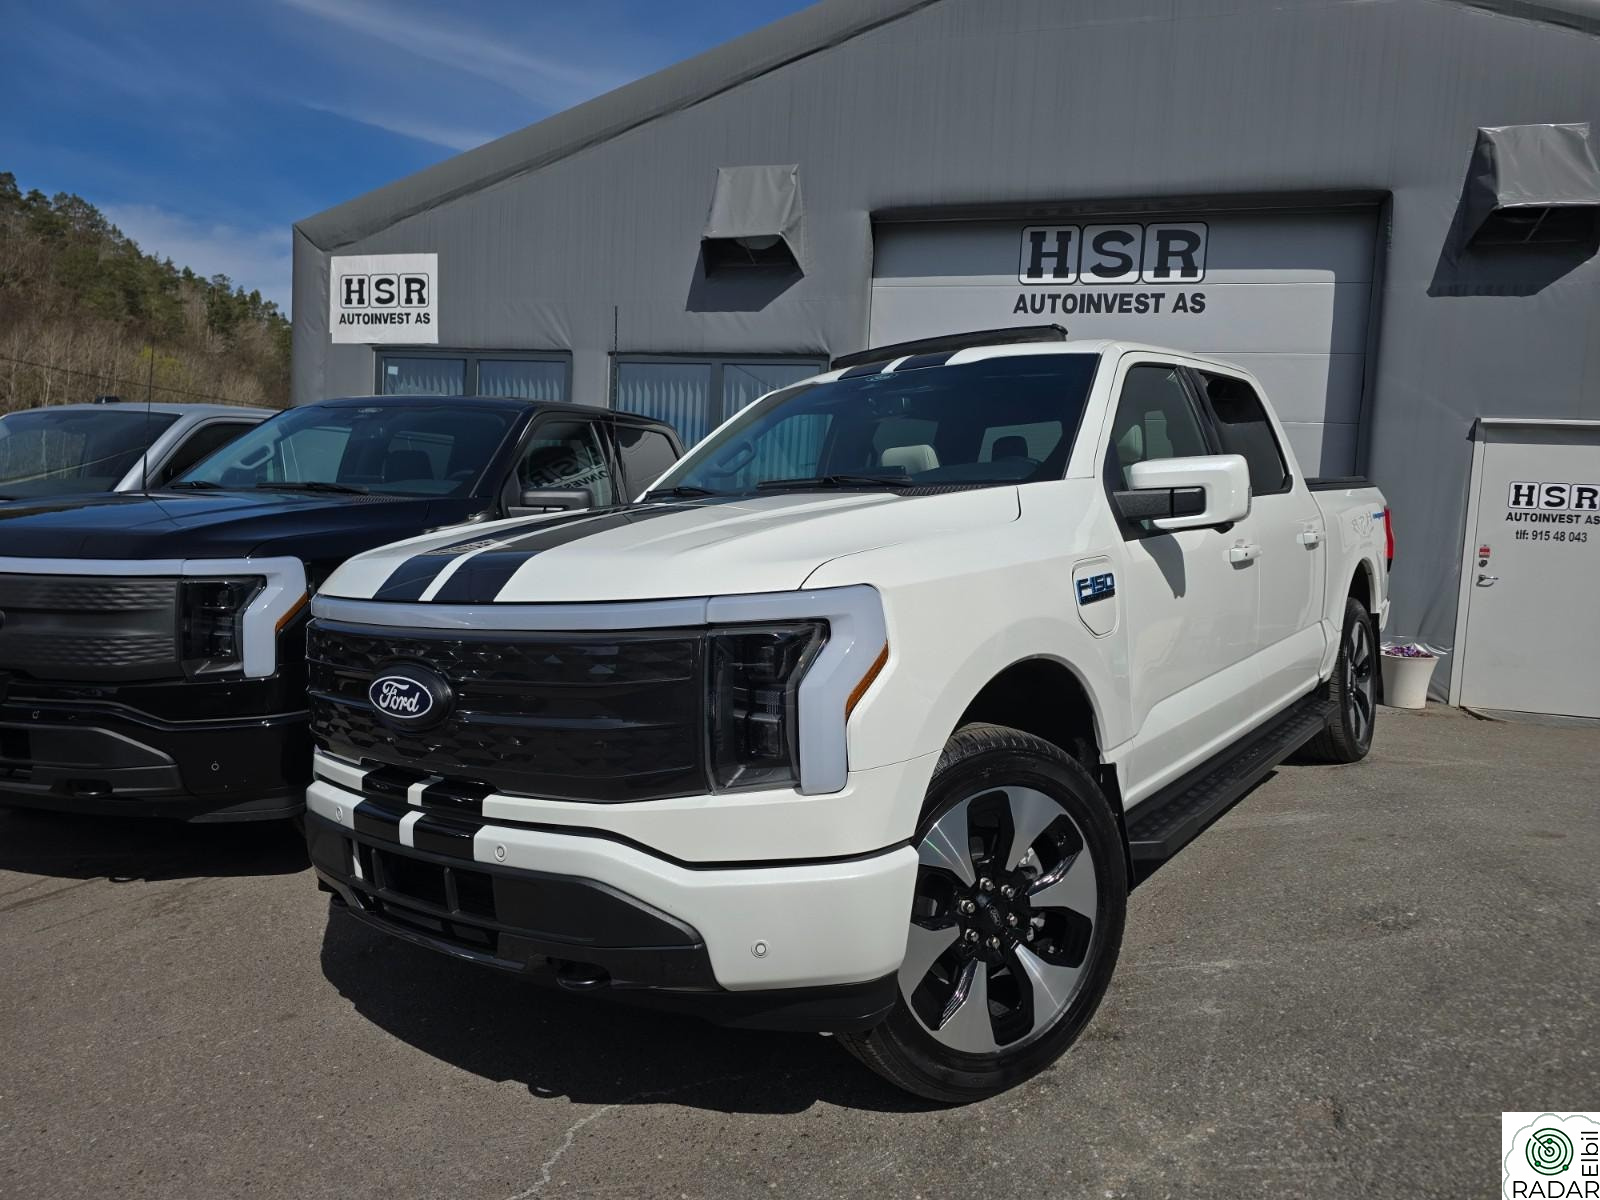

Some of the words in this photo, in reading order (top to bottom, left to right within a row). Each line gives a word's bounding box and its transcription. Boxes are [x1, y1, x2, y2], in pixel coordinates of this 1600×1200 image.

[1027, 229, 1201, 279] HSR
[344, 277, 426, 305] HSR
[1013, 293, 1165, 314] AUTOINVEST
[1172, 292, 1206, 314] AS
[339, 313, 411, 325] AUTOINVEST
[415, 312, 431, 324] AS
[1512, 484, 1599, 509] HSR
[1505, 512, 1582, 524] AUTOINVEST
[1585, 515, 1600, 525] AS
[1531, 530, 1551, 541] 915
[1553, 531, 1566, 542] 48
[1568, 532, 1588, 543] 043
[379, 681, 420, 712] Ford
